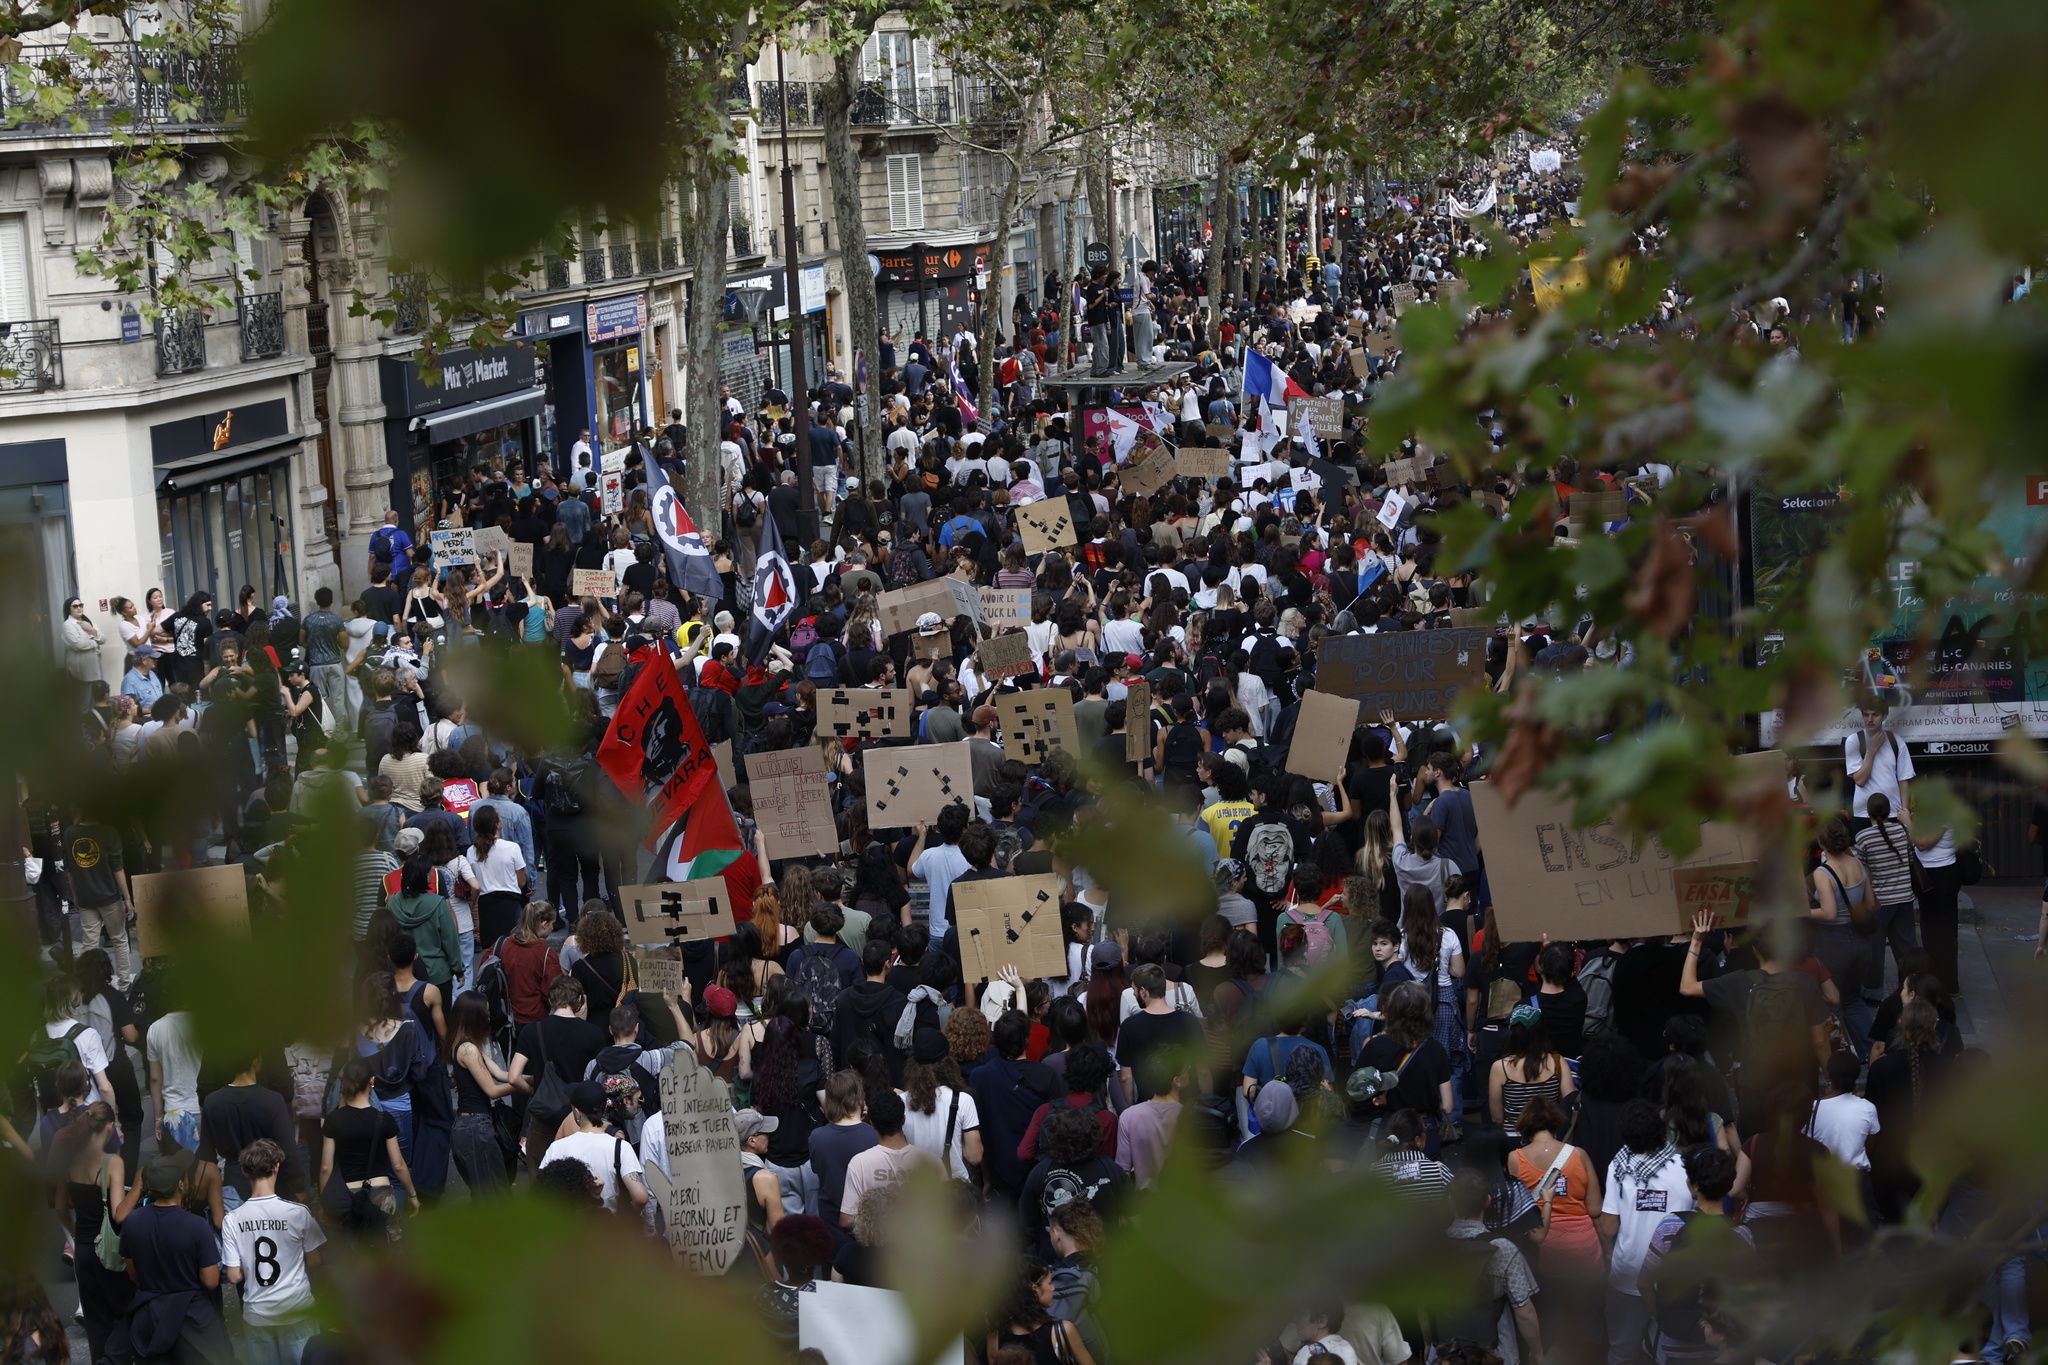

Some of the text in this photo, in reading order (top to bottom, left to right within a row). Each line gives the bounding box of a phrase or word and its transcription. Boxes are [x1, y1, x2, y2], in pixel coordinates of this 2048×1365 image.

[443, 366, 462, 391] Mix
[474, 355, 509, 383] Market
[1006, 594, 1015, 603] LE
[1007, 608, 1017, 618] LA
[1355, 657, 1438, 687] POUR
[616, 671, 669, 744] CHE
[1924, 716, 1949, 726] DANS
[1923, 742, 1990, 755] JDecaux
[646, 746, 713, 824] UEVARA
[1232, 808, 1238, 817] DE
[1574, 877, 1615, 907] EN
[1684, 882, 1732, 901] ENSA
[1003, 912, 1013, 945] FRGILE
[682, 1072, 698, 1094] 27
[689, 1121, 700, 1134] DE
[702, 1117, 730, 1134] TUER
[237, 1219, 289, 1234] VALVERDE
[669, 1205, 742, 1228] LECORNU ET
[254, 1235, 281, 1287] 8
[677, 1249, 727, 1275] TEMU
